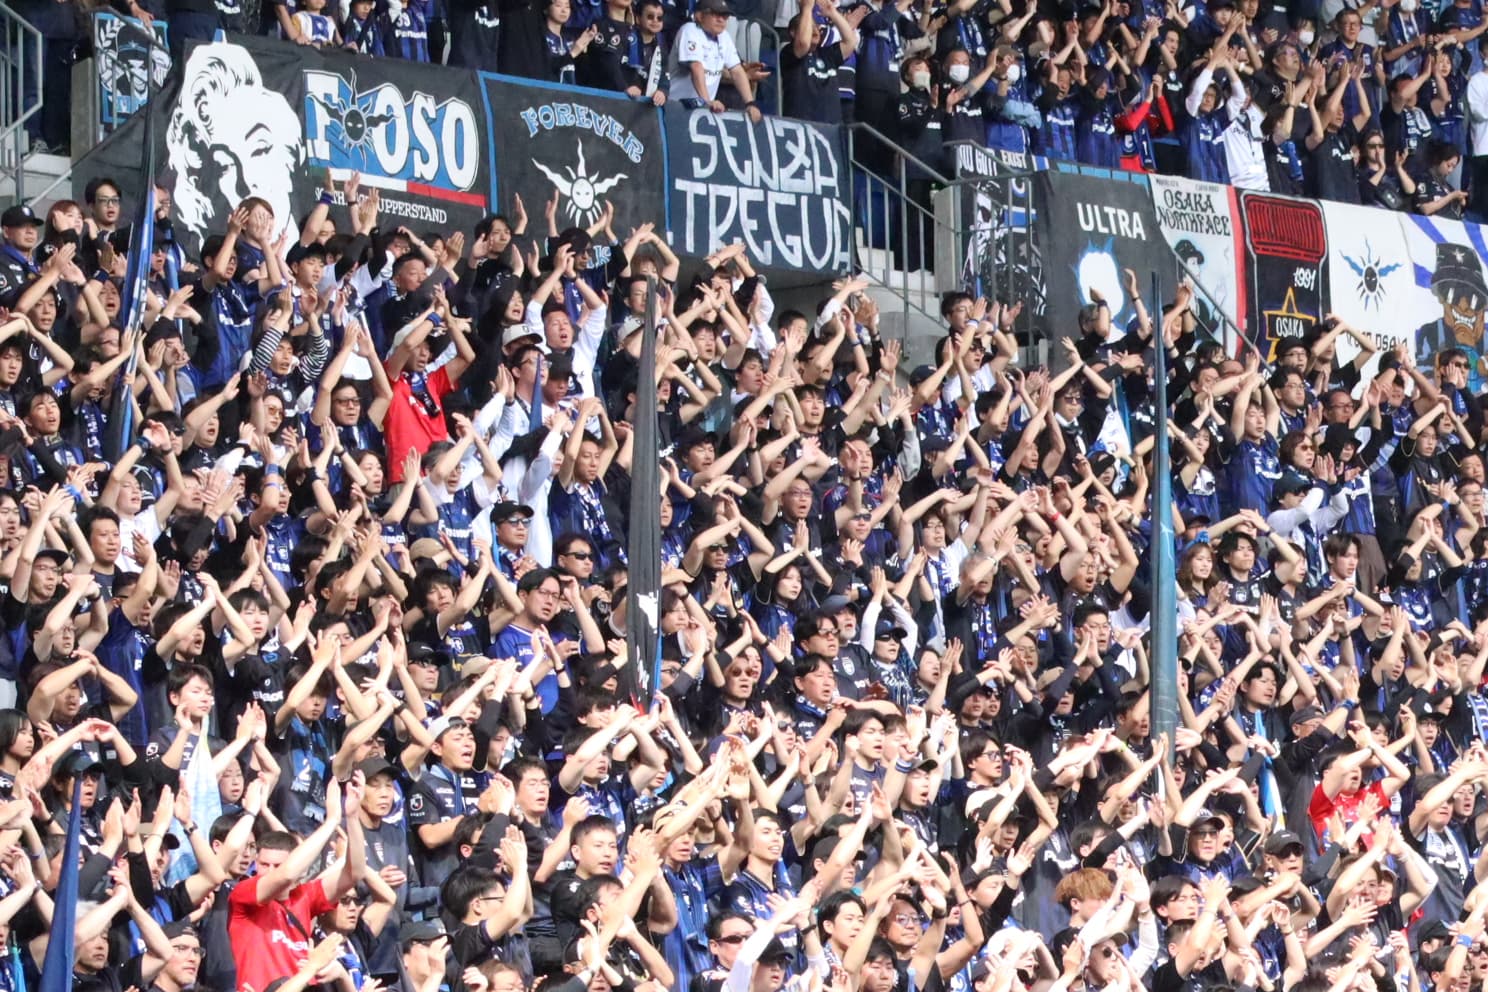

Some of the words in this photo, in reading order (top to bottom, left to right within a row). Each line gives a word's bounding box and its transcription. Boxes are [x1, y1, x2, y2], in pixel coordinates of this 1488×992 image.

[520, 102, 645, 164] FOREVER
[688, 107, 840, 198] SENZA
[1163, 188, 1216, 215] OSAKA
[675, 178, 852, 276] TREGUA
[1076, 202, 1147, 241] ULTRA
[1155, 206, 1231, 237] NORTHFACE
[1275, 318, 1305, 339] OSAKA
